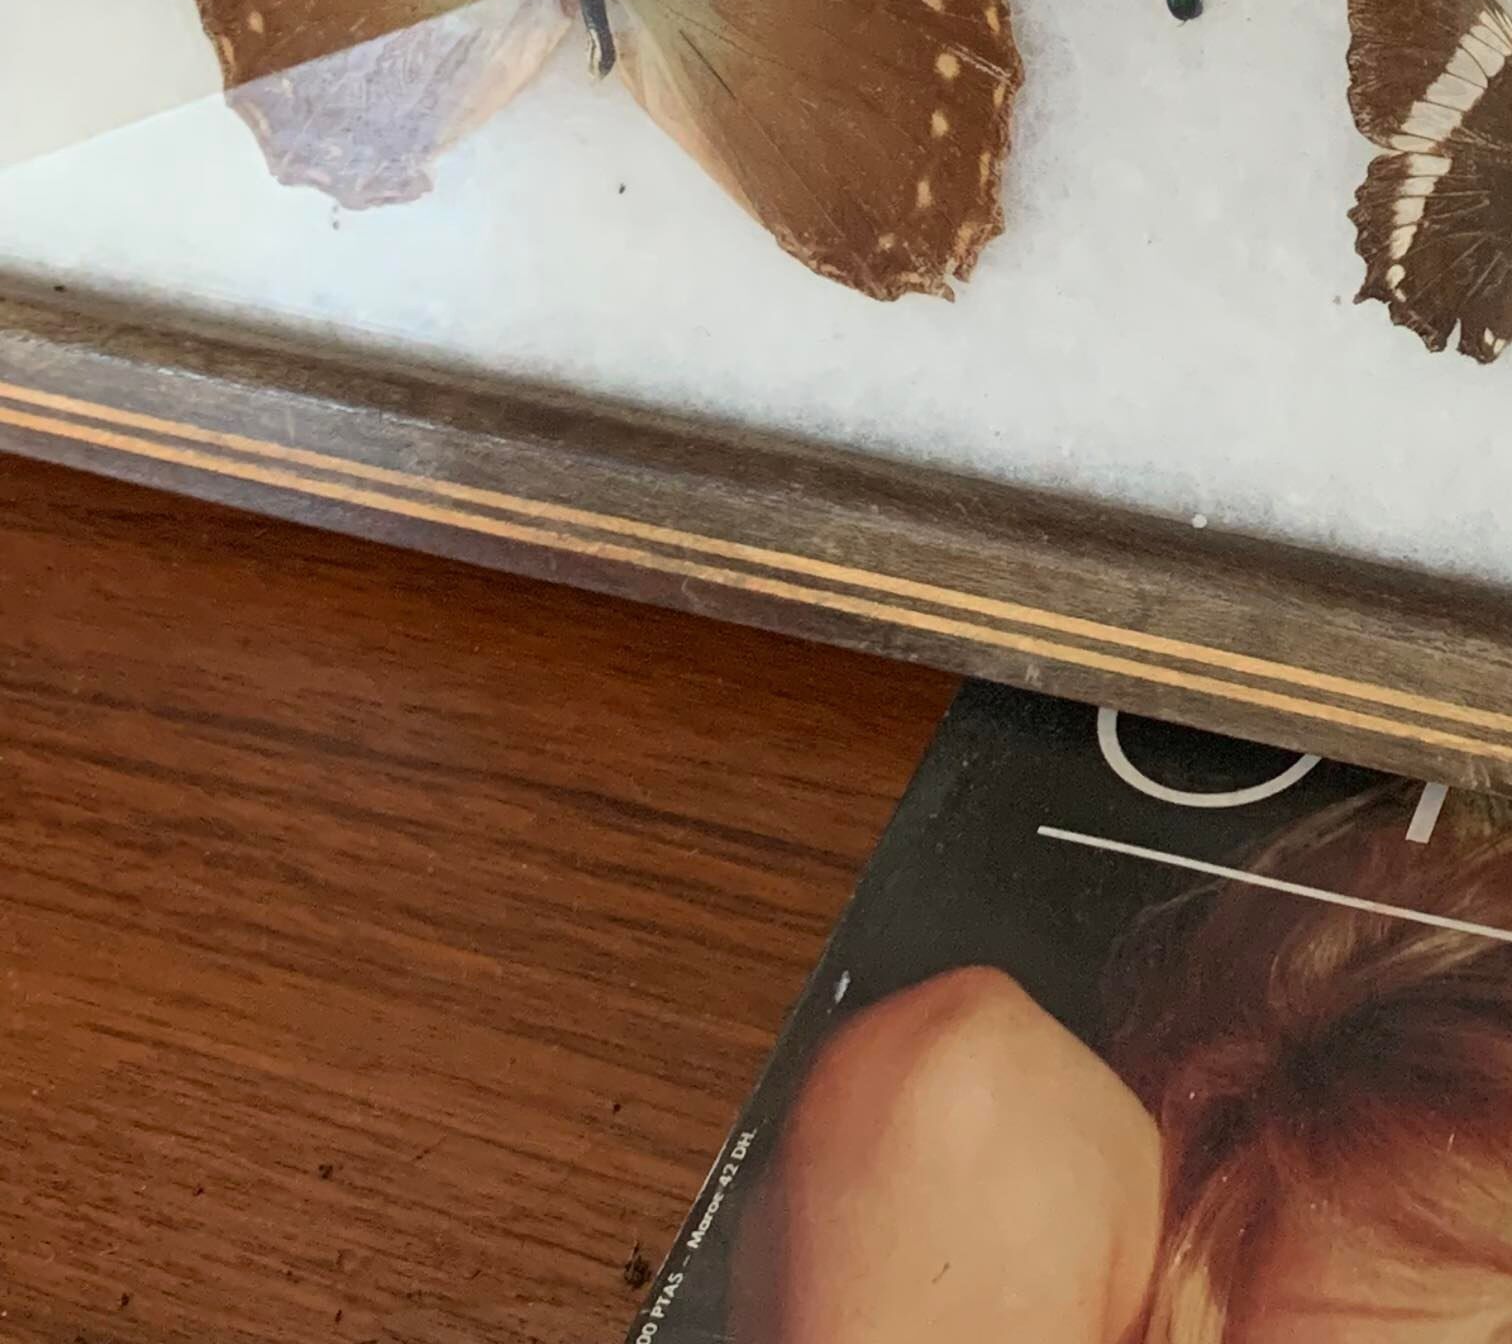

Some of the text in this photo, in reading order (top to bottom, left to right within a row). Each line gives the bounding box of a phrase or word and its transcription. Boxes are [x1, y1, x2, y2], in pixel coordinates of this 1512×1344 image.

[650, 1273, 684, 1318] PTAS
[687, 1192, 724, 1249] Maroc
[719, 1163, 739, 1187] 42
